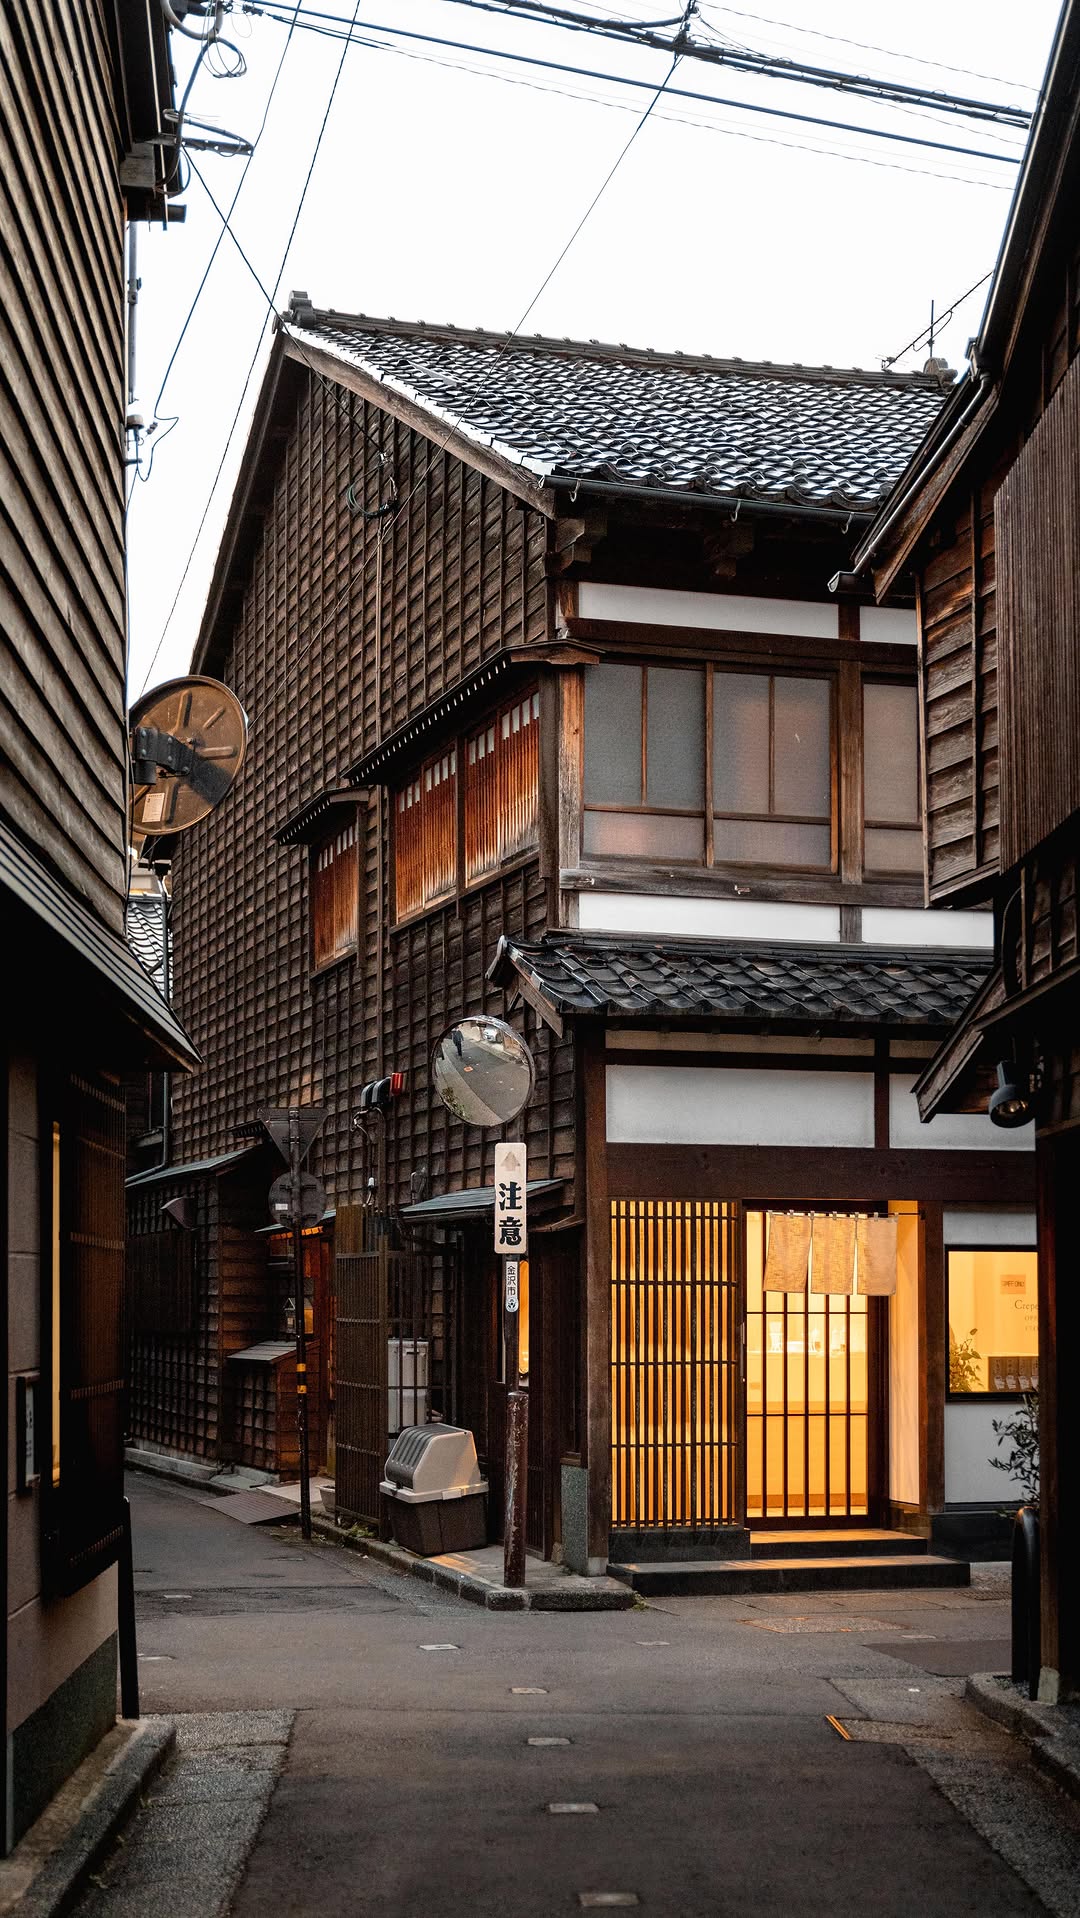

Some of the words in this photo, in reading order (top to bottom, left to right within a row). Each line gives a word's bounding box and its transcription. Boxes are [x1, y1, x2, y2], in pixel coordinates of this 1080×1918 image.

[498, 1181, 523, 1246] 注意
[507, 1265, 516, 1296] 金沢市
